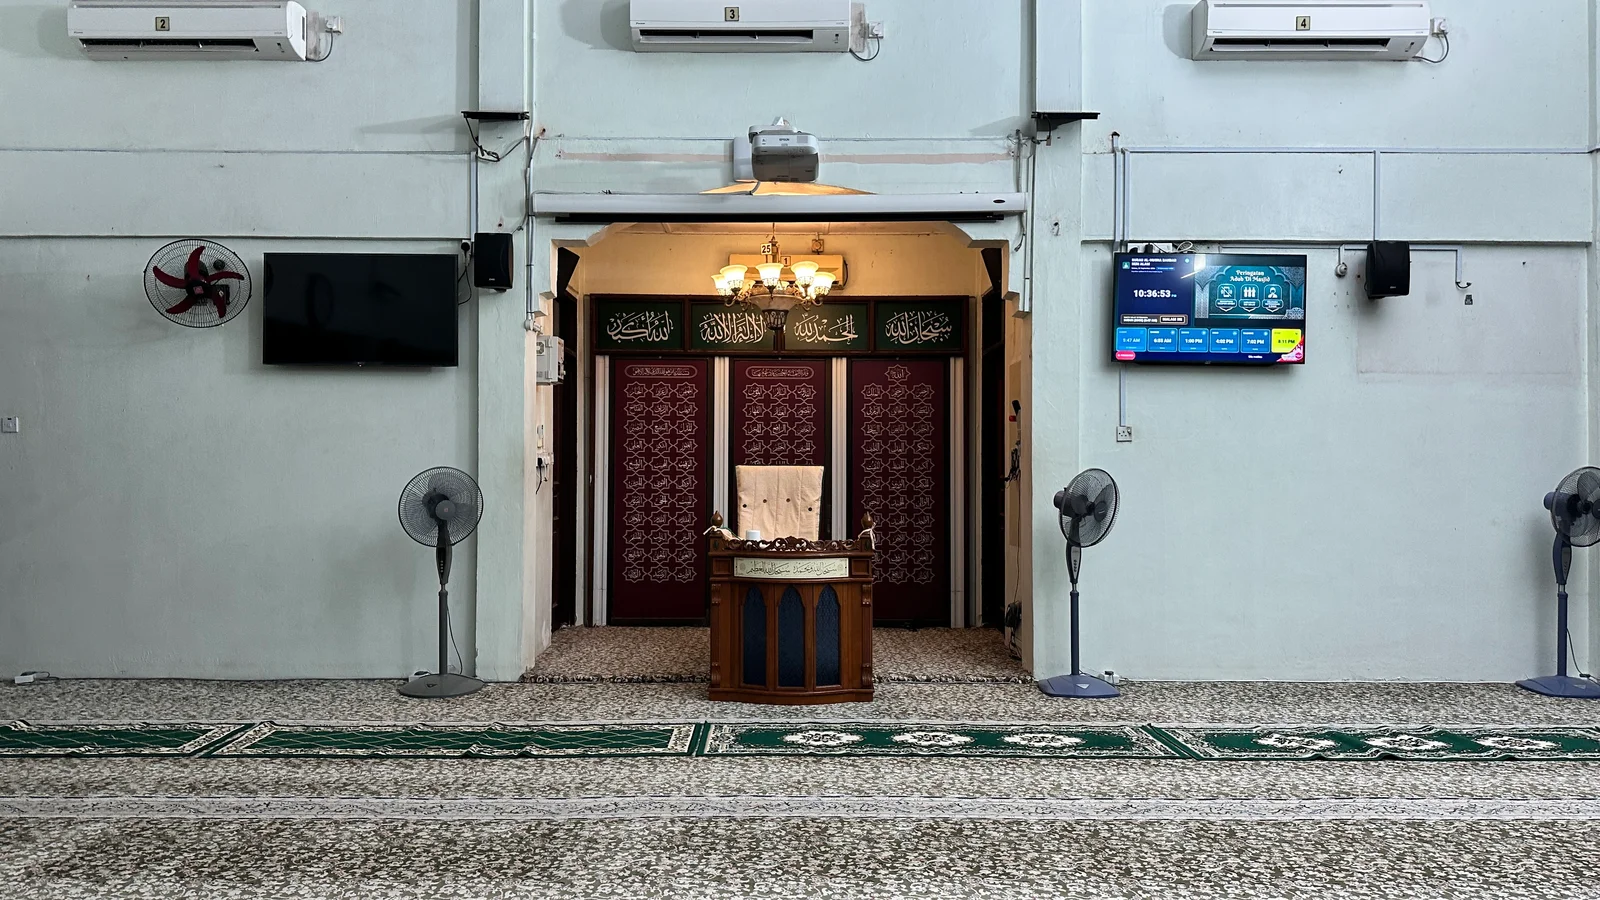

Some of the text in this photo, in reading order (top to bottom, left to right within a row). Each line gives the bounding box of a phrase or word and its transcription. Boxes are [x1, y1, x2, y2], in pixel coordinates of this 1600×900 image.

[729, 9, 736, 19] 3
[159, 19, 166, 29] 2
[1300, 18, 1307, 28] 4
[761, 244, 771, 254] 25
[783, 257, 788, 265] 1
[1133, 290, 1171, 298] 10:36:53
